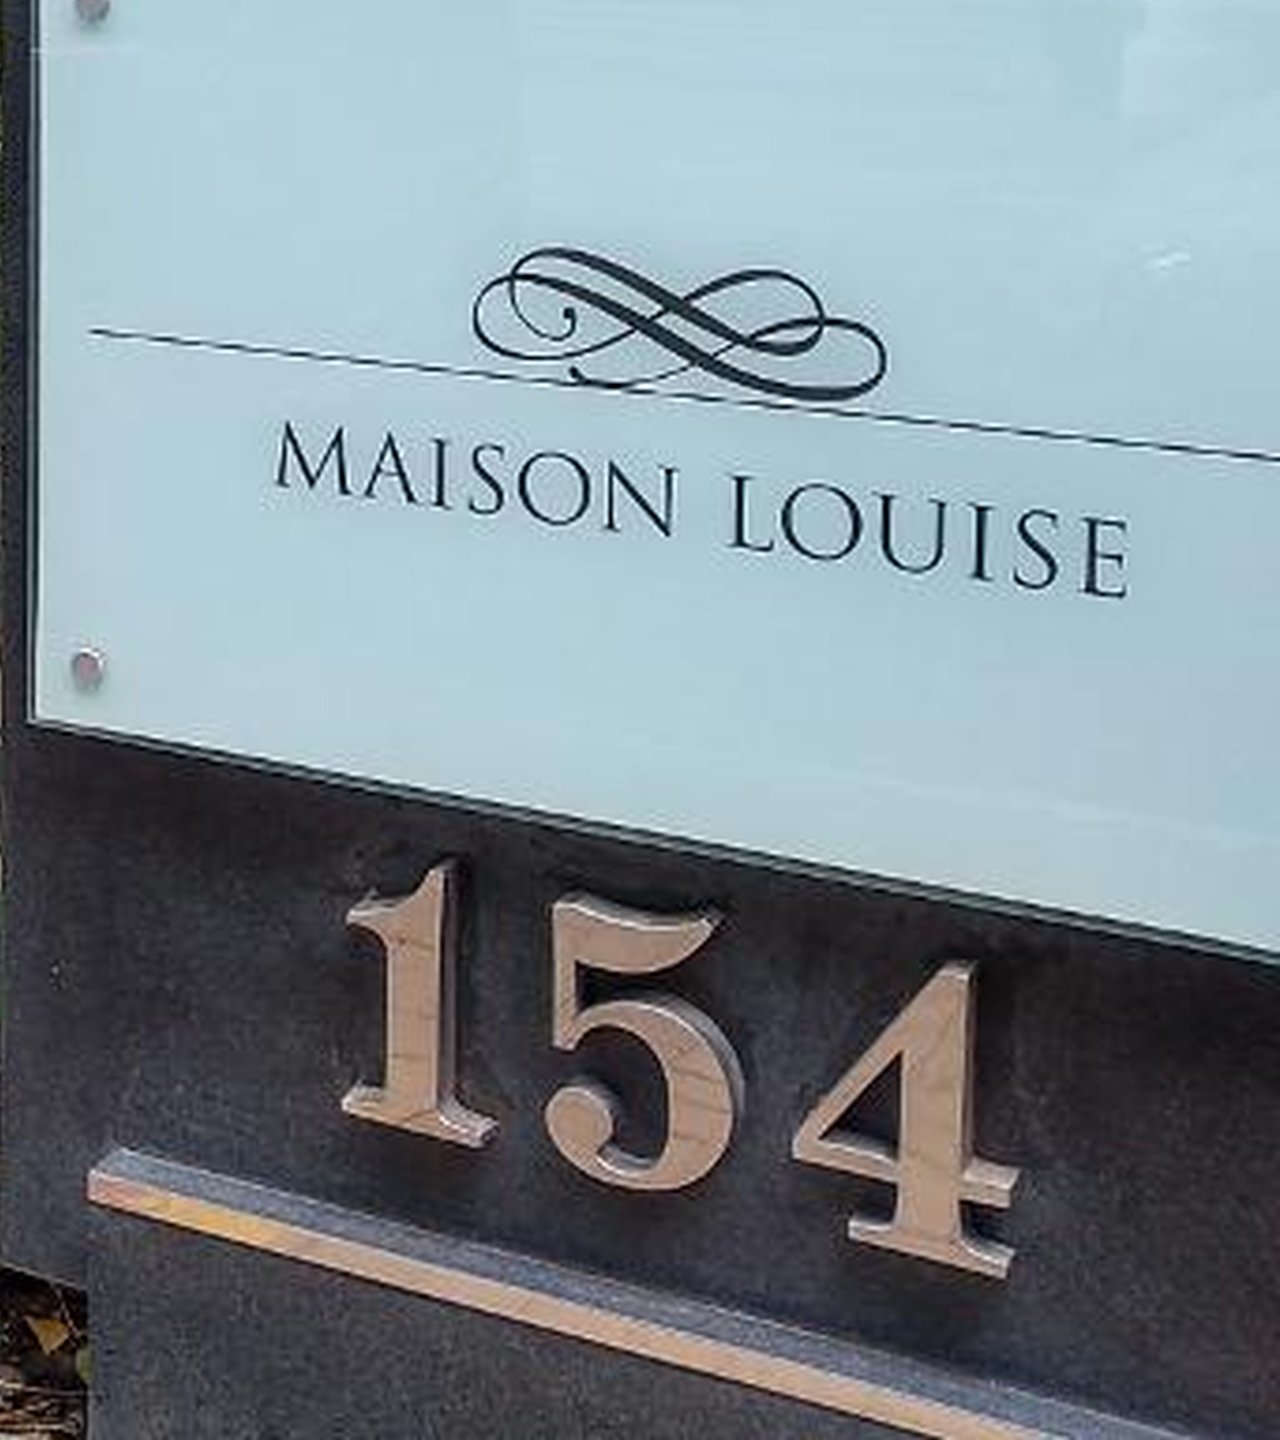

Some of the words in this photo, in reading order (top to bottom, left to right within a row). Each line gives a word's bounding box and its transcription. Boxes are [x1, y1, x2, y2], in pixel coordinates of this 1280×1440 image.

[274, 420, 679, 538] MAISON
[726, 472, 1129, 600] LOUISE
[340, 860, 1024, 1279] 154
